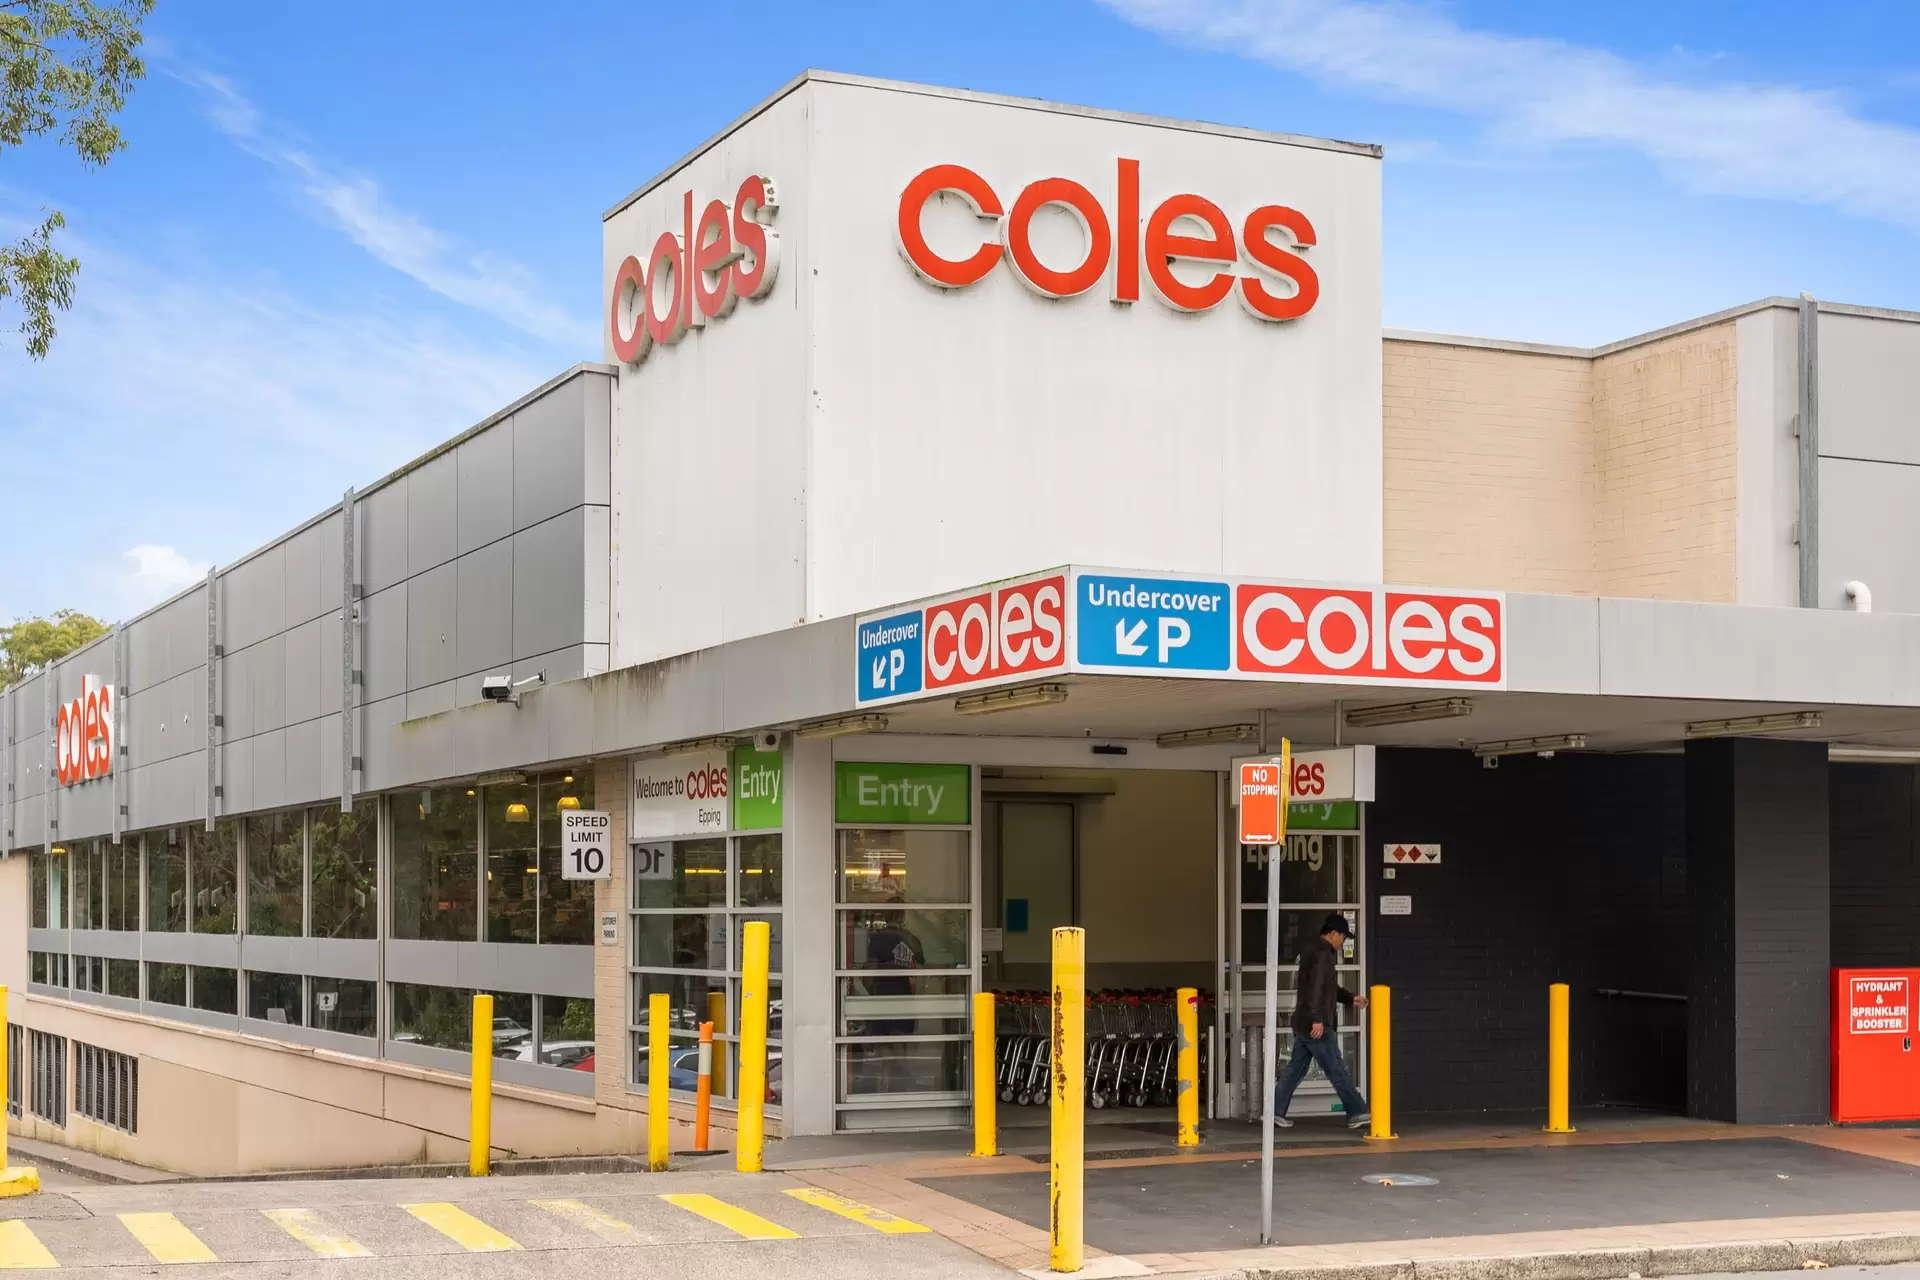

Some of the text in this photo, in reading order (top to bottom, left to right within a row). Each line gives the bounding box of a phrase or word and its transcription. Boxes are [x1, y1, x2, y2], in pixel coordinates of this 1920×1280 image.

[898, 158, 1319, 323] coles
[611, 174, 775, 365] coles
[1088, 583, 1222, 613] Undercover
[862, 623, 919, 649] Undercover
[927, 585, 1063, 682] coles
[1157, 616, 1192, 664] P
[1242, 590, 1496, 676] coles
[890, 649, 905, 691] P
[57, 673, 112, 785] coles
[635, 762, 728, 800] Welcome to coles
[740, 765, 780, 804] Entry
[1242, 784, 1278, 796] STOPPING
[1252, 769, 1268, 782] NO
[1290, 758, 1325, 796] les
[858, 775, 945, 815] Entry
[566, 816, 608, 827] SPEED
[699, 808, 721, 825] Epping
[571, 832, 603, 842] LIMIT
[571, 848, 604, 873] 10
[1856, 982, 1903, 992] HYDRANT
[1876, 994, 1883, 1004] &
[1852, 1006, 1907, 1017] SPRINKLER
[1857, 1018, 1902, 1029] BOOSTER
